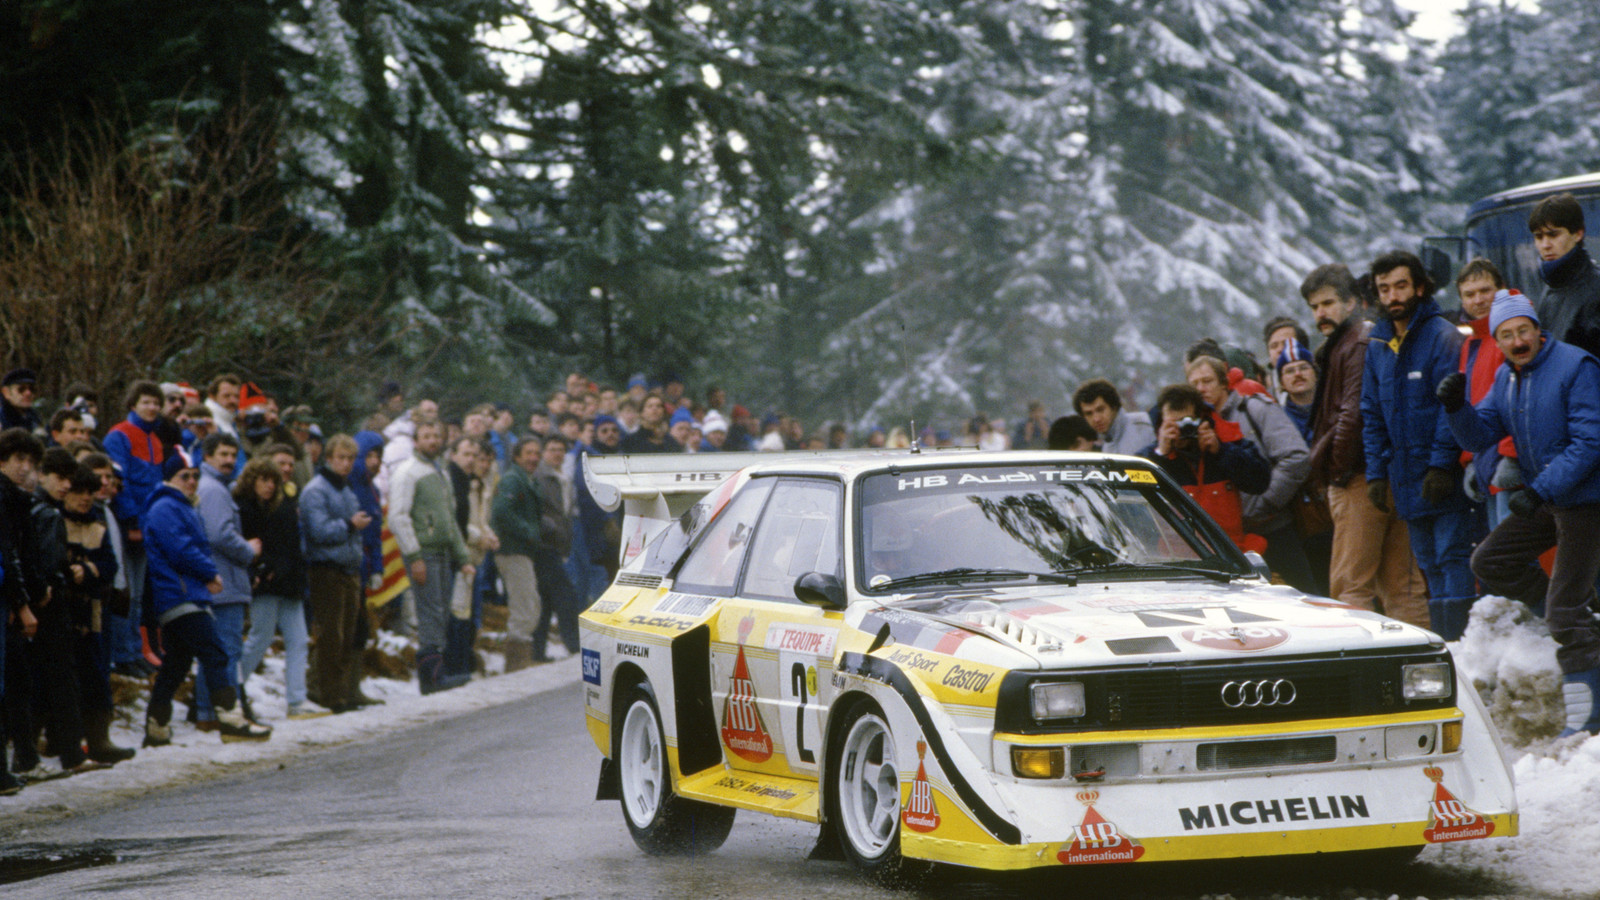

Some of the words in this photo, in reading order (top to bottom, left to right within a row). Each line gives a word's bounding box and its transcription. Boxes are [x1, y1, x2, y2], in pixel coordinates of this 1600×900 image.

[675, 473, 722, 482] HB
[898, 475, 949, 491] HB
[1039, 470, 1131, 482] TEAM
[629, 615, 694, 631] quattro
[616, 643, 650, 658] MICHELIN
[888, 650, 912, 663] Audi
[907, 653, 940, 673] Sport
[583, 655, 600, 678] SKF
[942, 664, 995, 694] Castrol
[729, 677, 757, 733] HB
[791, 662, 817, 764] 2
[727, 733, 769, 754] international
[912, 780, 931, 815] HB
[906, 813, 937, 828] international
[1178, 795, 1371, 831] MICHELIN
[1429, 800, 1477, 828] HB
[1073, 821, 1123, 850] HB
[1432, 825, 1488, 841] international
[1068, 849, 1135, 863] international
